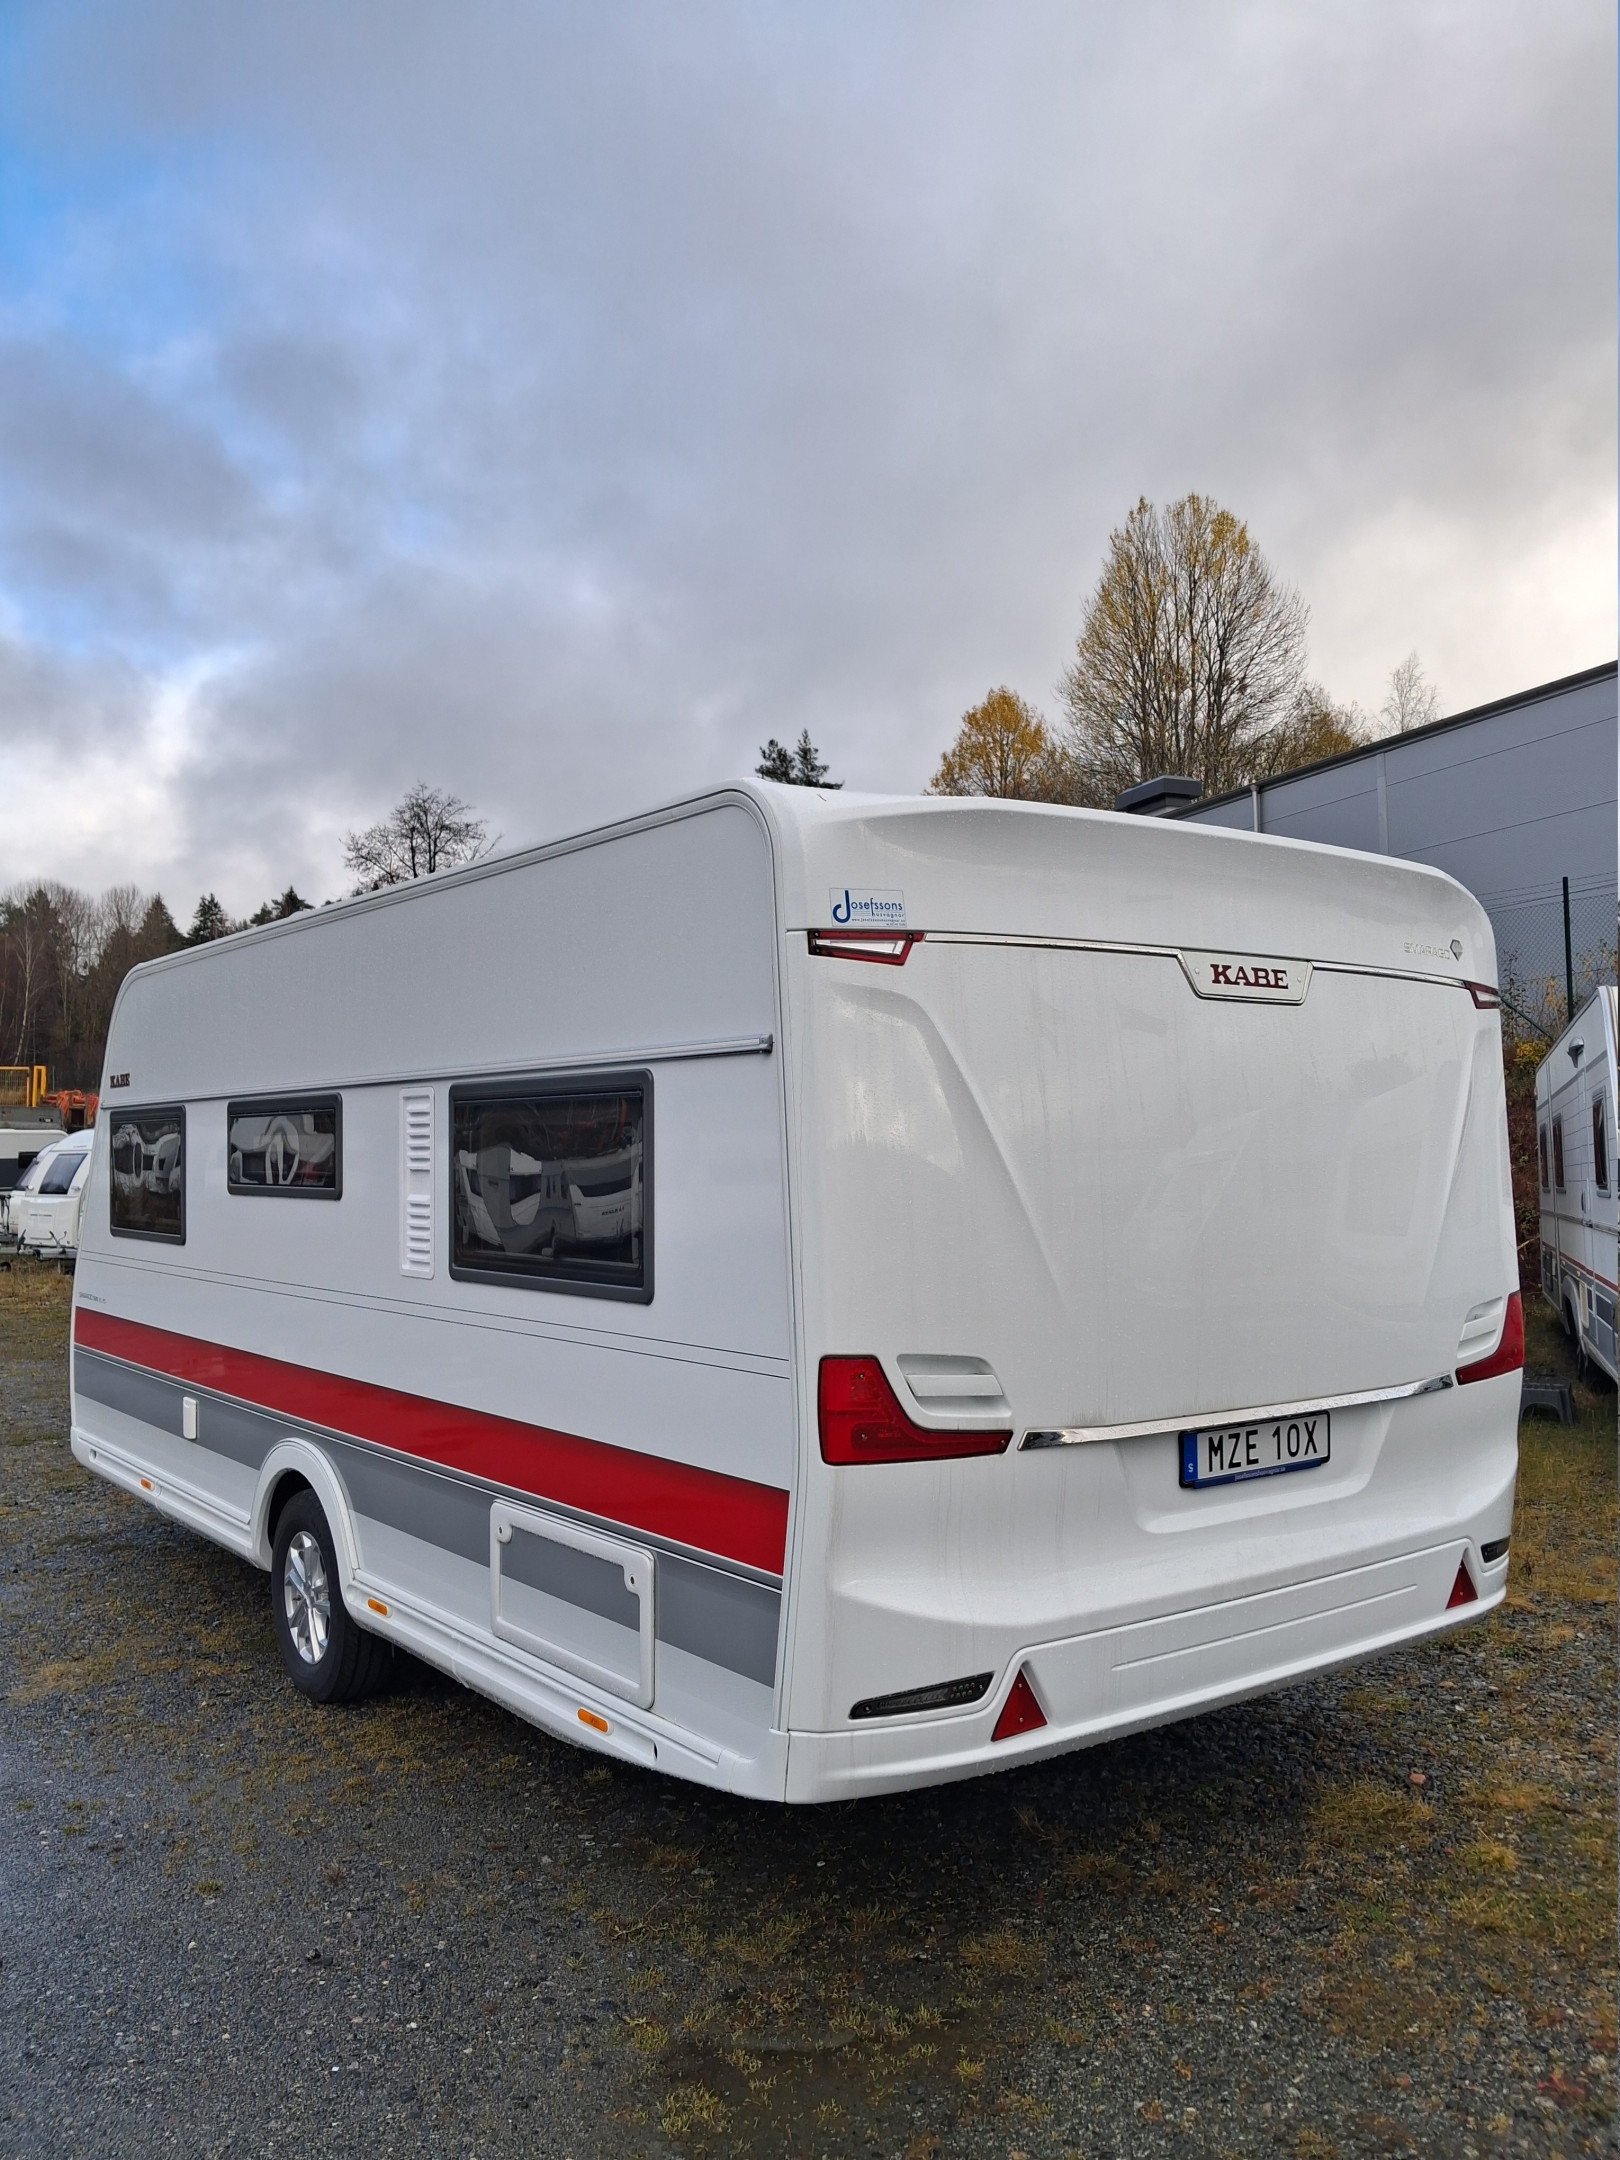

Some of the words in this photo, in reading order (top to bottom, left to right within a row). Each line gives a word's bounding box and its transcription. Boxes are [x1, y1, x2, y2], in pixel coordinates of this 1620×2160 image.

[832, 890, 903, 923] Josefssons
[1210, 963, 1289, 989] KABE
[110, 1073, 130, 1089] KABE
[1208, 1429, 1260, 1472] MZE
[1272, 1420, 1318, 1460] 10X
[1188, 1463, 1194, 1473] S
